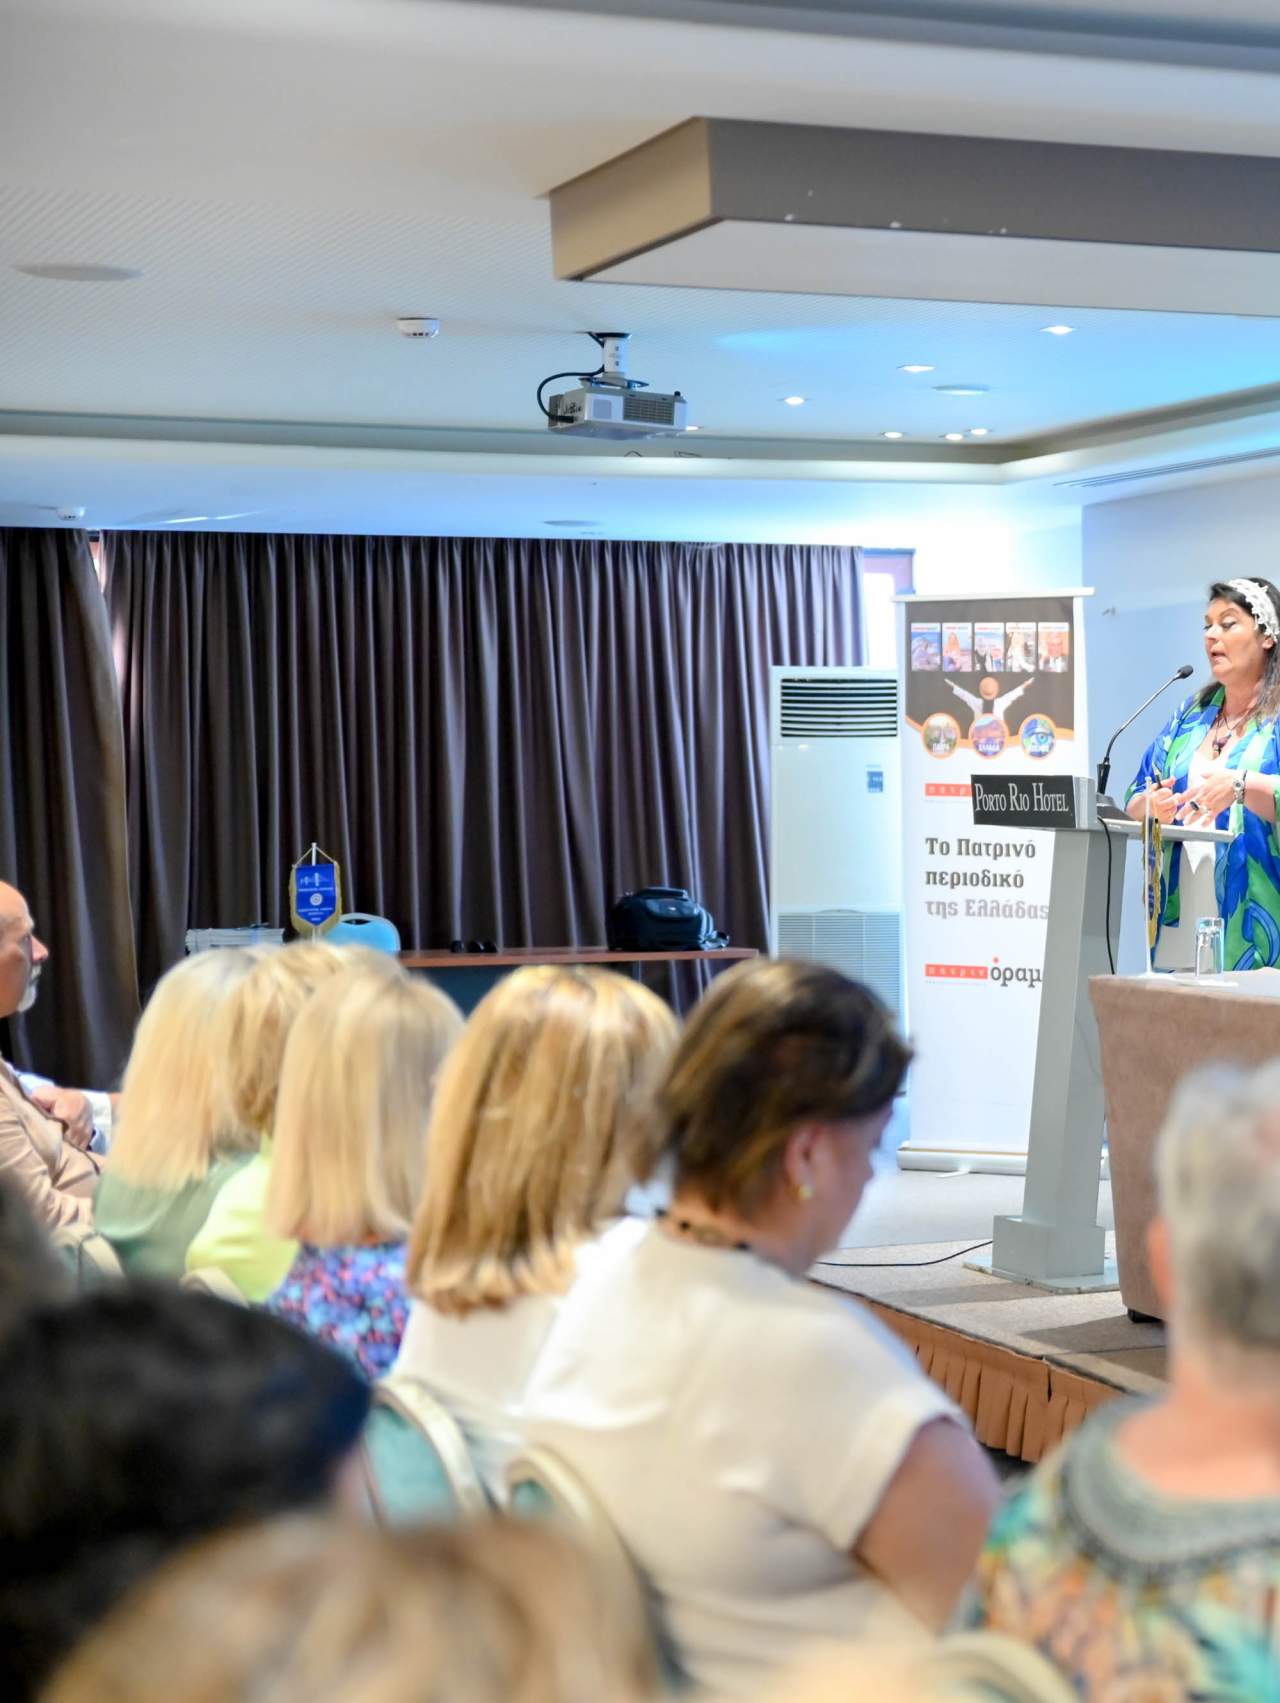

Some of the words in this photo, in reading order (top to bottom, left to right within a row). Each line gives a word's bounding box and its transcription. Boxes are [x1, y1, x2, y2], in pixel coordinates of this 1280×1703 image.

[975, 783, 1007, 811] PORTO
[1008, 783, 1030, 811] RIO
[1032, 782, 1069, 812] HOTEL
[925, 837, 951, 856] Το
[957, 838, 1036, 860] Πατρινό
[925, 869, 1025, 889] περιοδικό
[925, 900, 959, 919] της
[965, 899, 1050, 920] Ελλάδας
